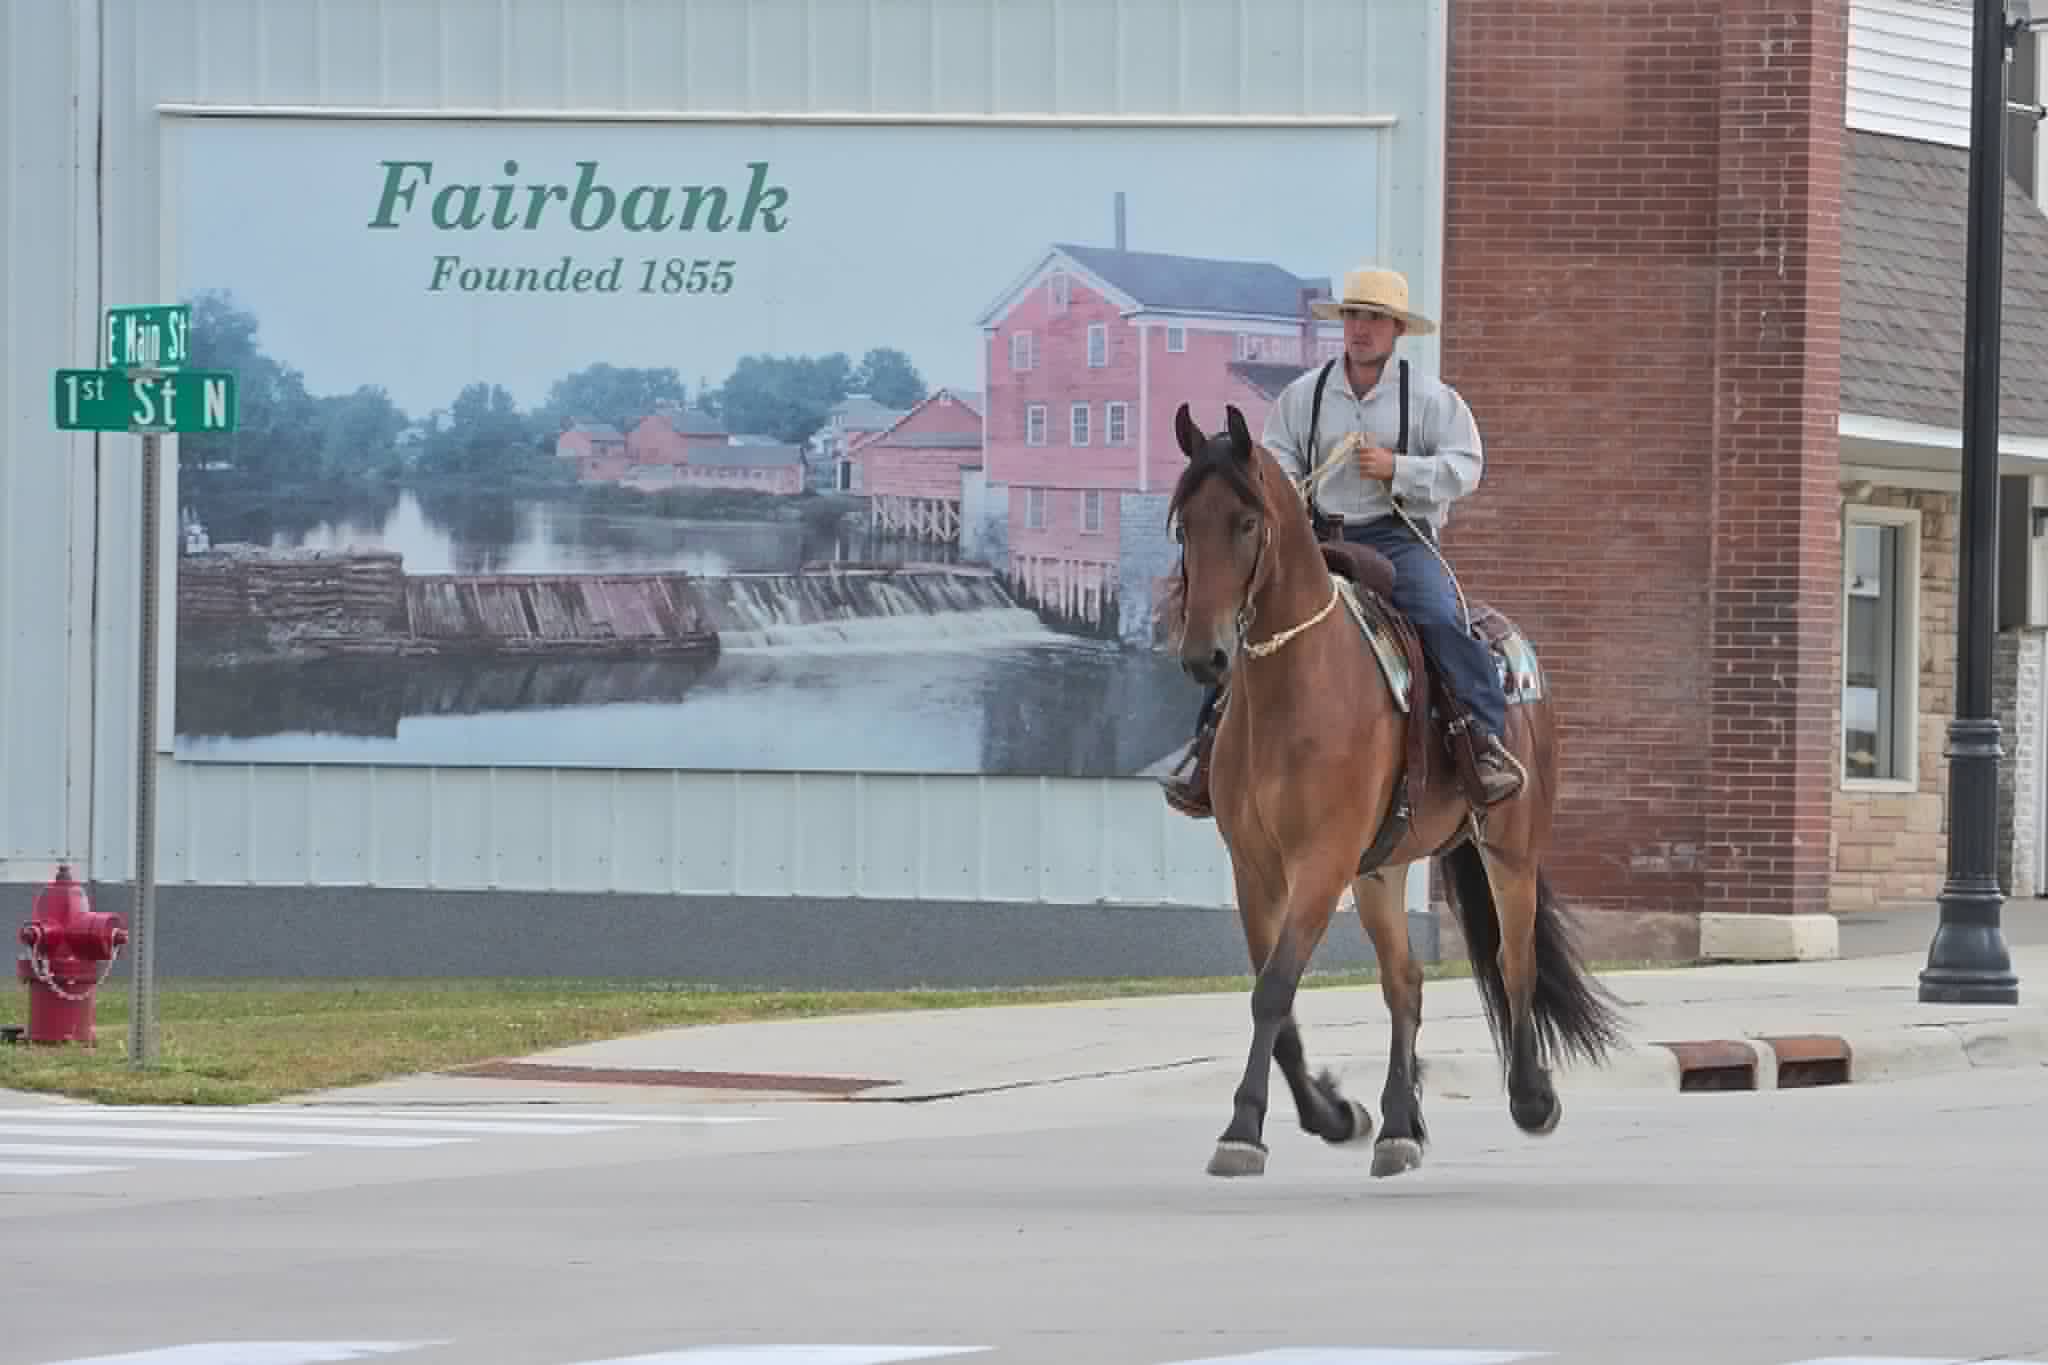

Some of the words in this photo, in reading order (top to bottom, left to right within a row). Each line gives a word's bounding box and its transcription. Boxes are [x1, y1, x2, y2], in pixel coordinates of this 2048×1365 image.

[367, 160, 789, 233] Fairbank
[427, 256, 624, 292] Founded
[637, 258, 736, 294] 1855
[107, 315, 118, 364] E
[125, 313, 161, 364] Main
[168, 311, 187, 360] St
[64, 375, 105, 424] 1st
[132, 377, 177, 425] St
[203, 379, 226, 428] N
